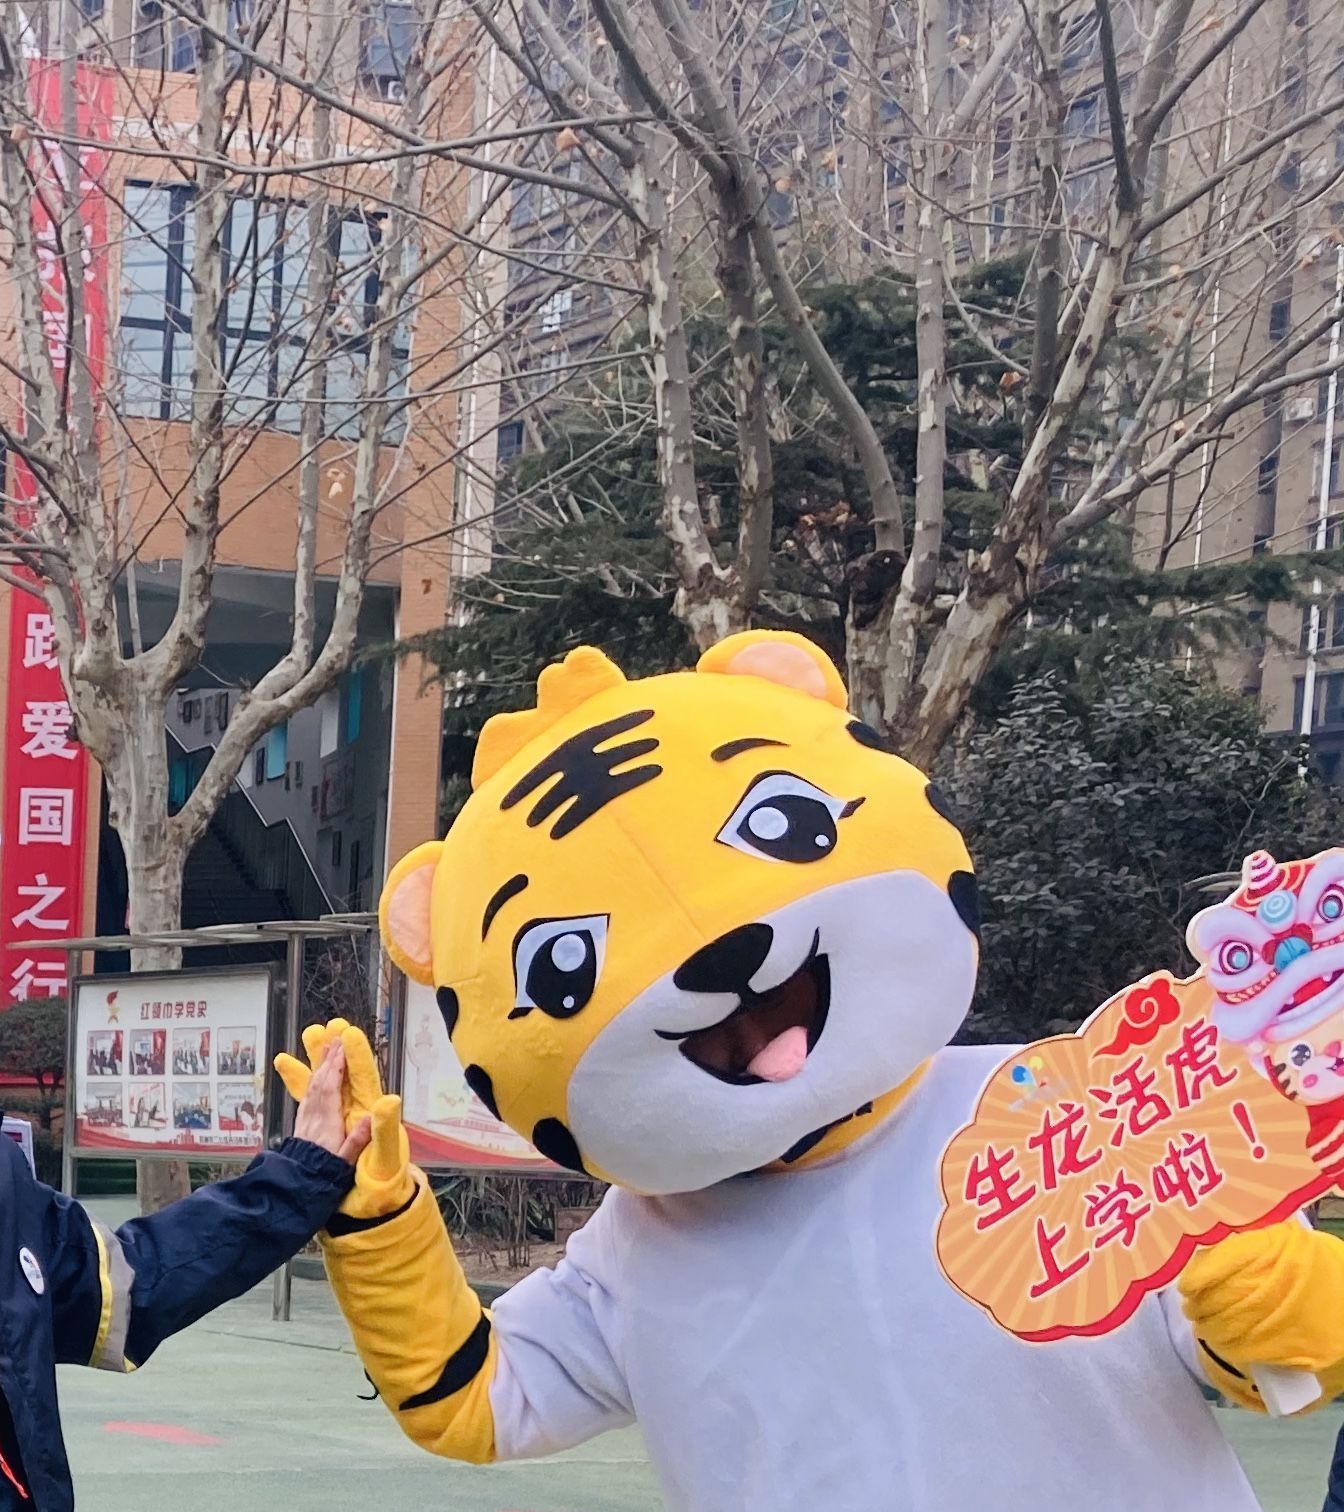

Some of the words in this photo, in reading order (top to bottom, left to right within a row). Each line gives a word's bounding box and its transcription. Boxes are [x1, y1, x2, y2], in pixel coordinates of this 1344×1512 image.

[139, 1000, 208, 1021] 红领巾学党史
[964, 1016, 1239, 1231] 生龙活虎
[1029, 1101, 1267, 1299] 上学啦！
